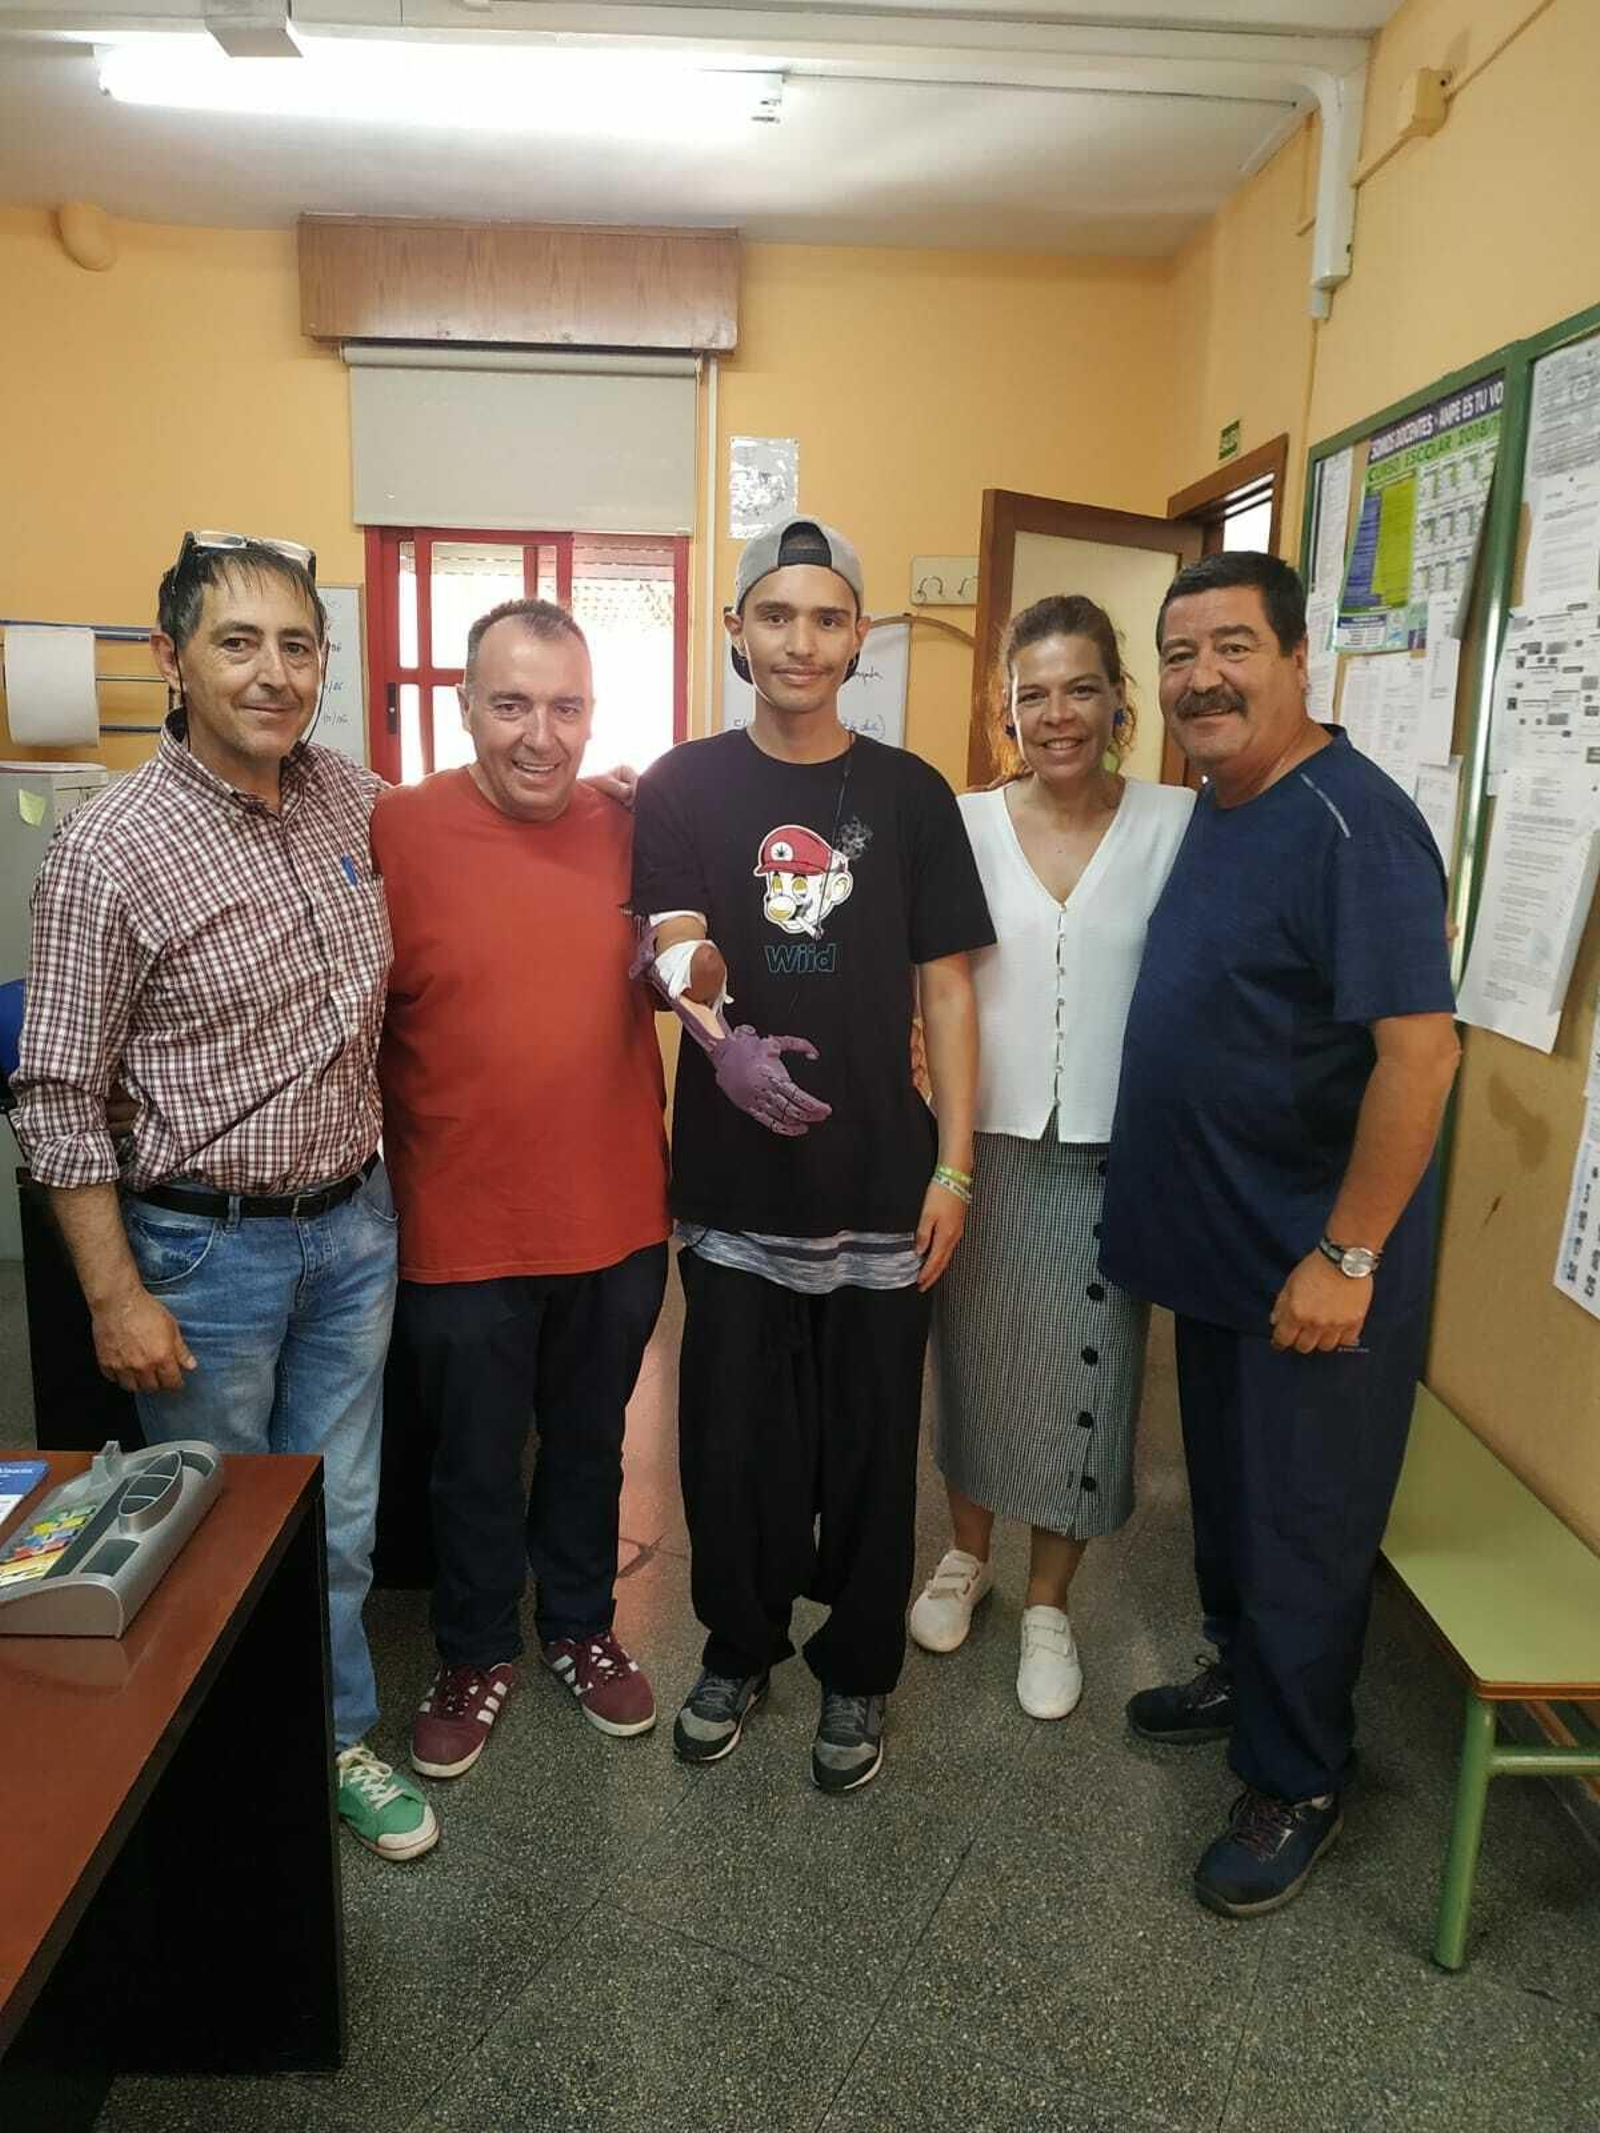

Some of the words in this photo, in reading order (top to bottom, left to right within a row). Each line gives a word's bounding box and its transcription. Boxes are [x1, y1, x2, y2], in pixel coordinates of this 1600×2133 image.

[1462, 393, 1474, 418] ES
[1475, 387, 1488, 412] TU
[1405, 434, 1451, 467] ESCOLAR
